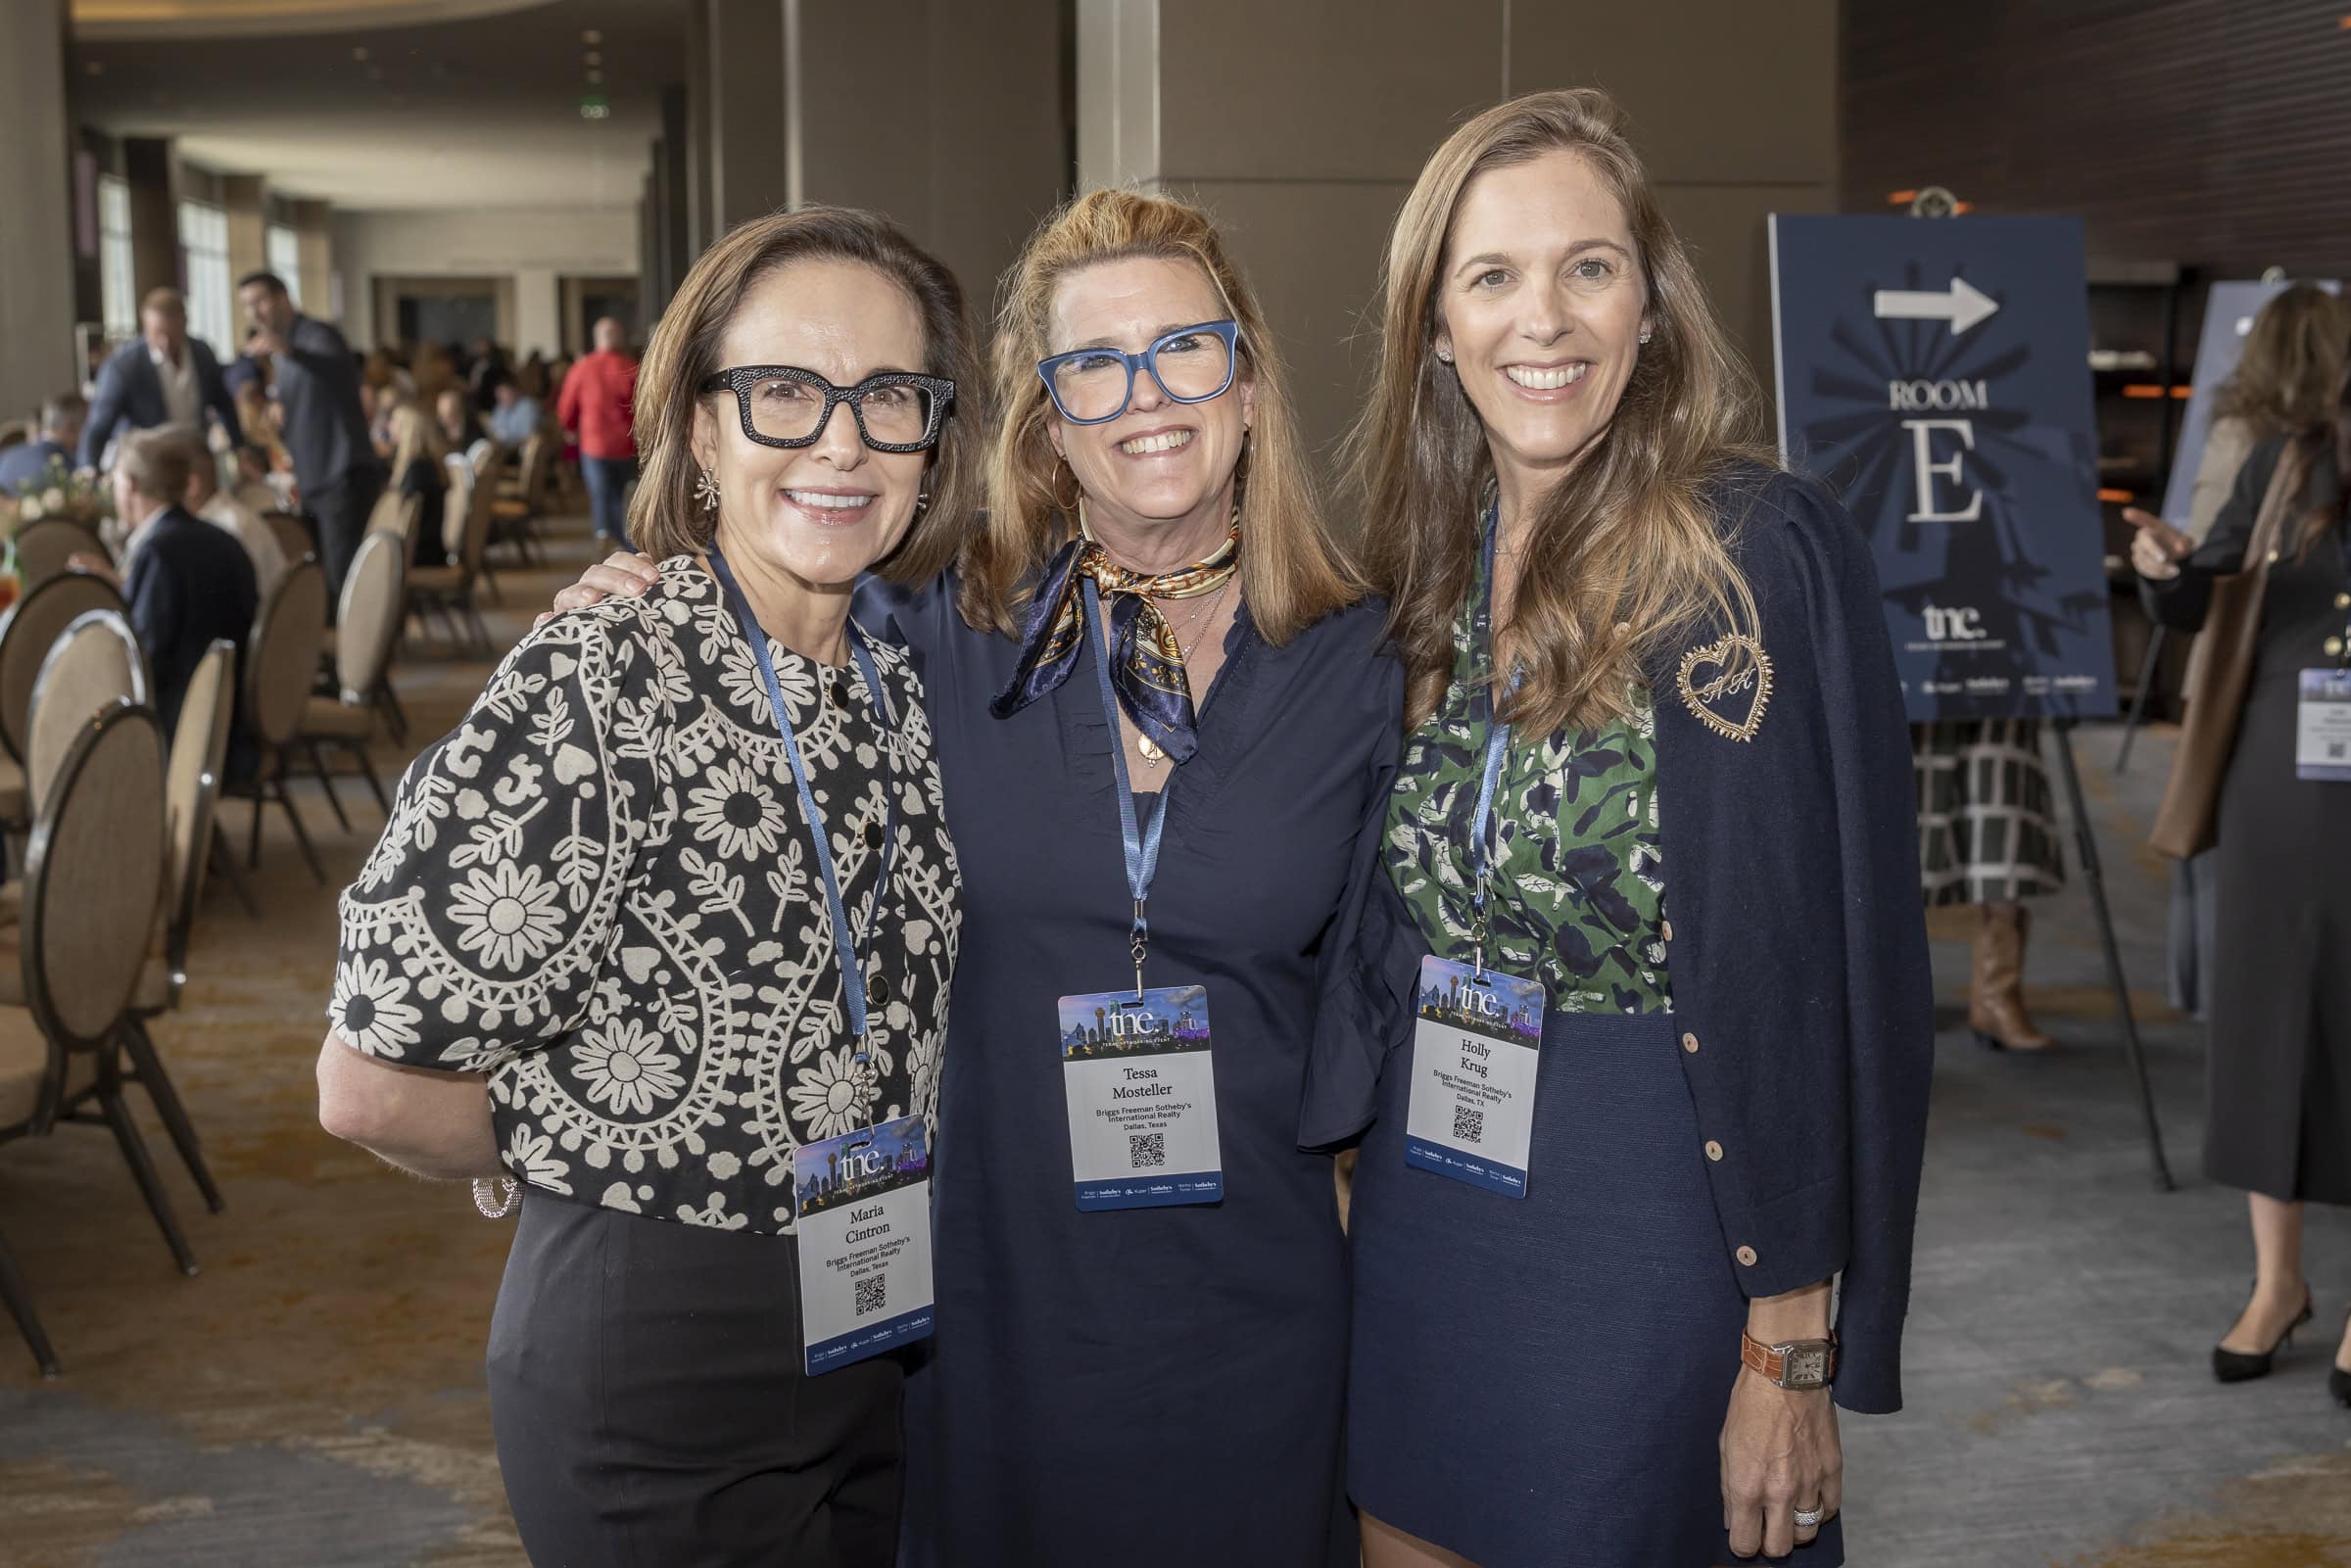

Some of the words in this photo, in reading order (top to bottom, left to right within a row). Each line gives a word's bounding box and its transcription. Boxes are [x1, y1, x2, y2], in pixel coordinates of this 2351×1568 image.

[1889, 379, 1989, 410] ROOM
[1901, 418, 1984, 523] E
[1462, 1039, 1491, 1061] Holly
[1123, 1068, 1158, 1080] Tessa
[1461, 1057, 1488, 1077] Krug
[1112, 1084, 1173, 1100] Mosteller
[1433, 1069, 1453, 1081] Briggs
[1454, 1075, 1480, 1089] Freeman
[1481, 1083, 1511, 1099] Sotheby's
[1442, 1079, 1481, 1097] International
[1482, 1092, 1502, 1104] Realty
[1096, 1108, 1120, 1117] Briggs
[1121, 1106, 1154, 1115] Freeman
[1155, 1102, 1192, 1112] Sotheby's
[1476, 1098, 1485, 1107] TX
[1108, 1113, 1156, 1123] International
[1157, 1111, 1181, 1119] Realty
[850, 1206, 885, 1224] Maria
[845, 1222, 890, 1245] Cintron
[826, 1255, 848, 1267] Briggs
[848, 1247, 878, 1260] Freeman
[879, 1237, 910, 1252] Sotheby's
[837, 1254, 880, 1272] International
[881, 1247, 900, 1259] Realty
[872, 1260, 888, 1270] Texas
